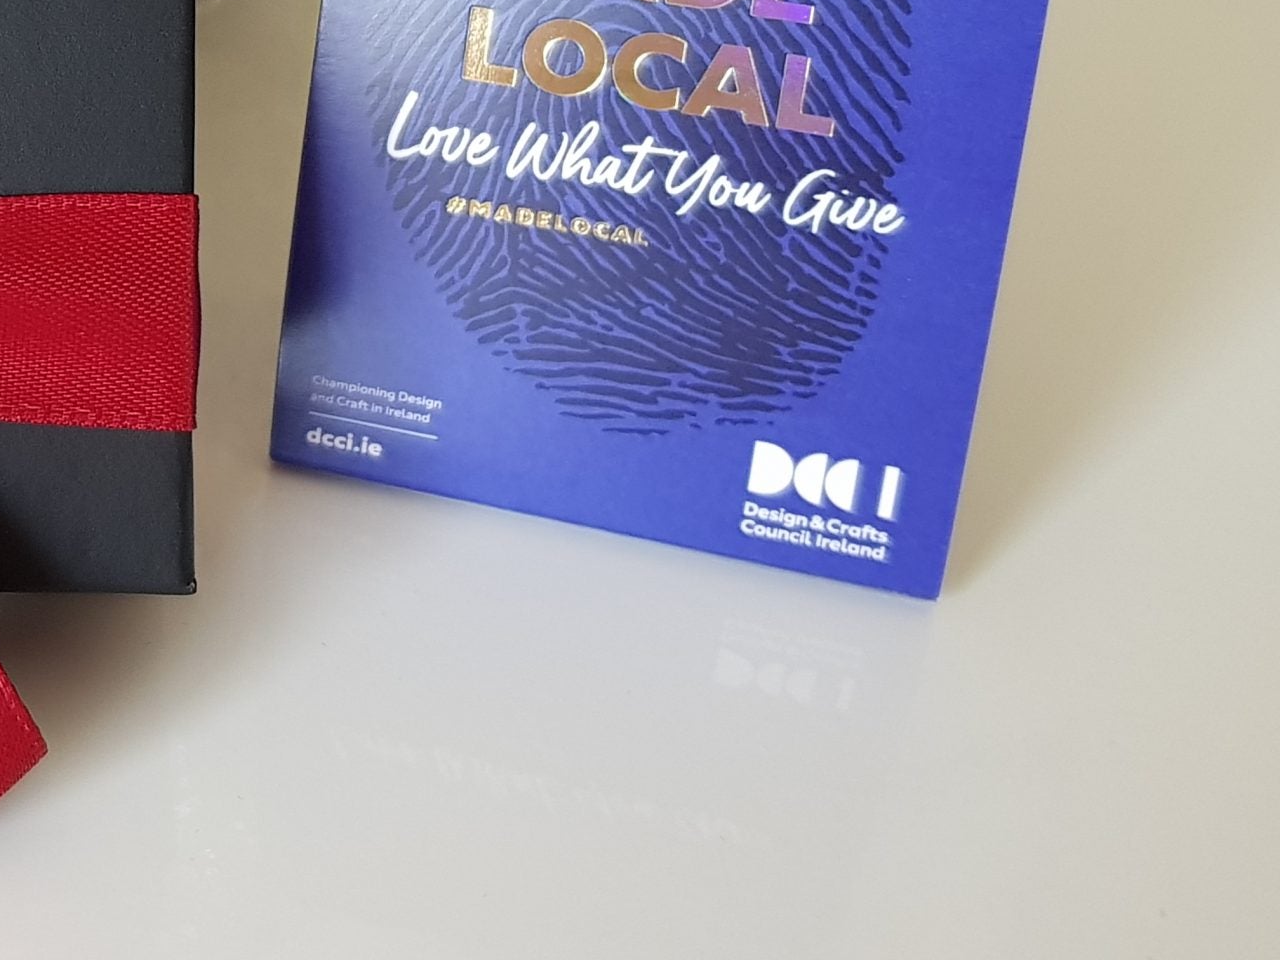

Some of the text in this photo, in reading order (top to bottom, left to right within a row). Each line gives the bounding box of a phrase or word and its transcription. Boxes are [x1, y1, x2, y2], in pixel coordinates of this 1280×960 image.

[462, 5, 836, 138] LOCAL
[387, 91, 905, 235] Love What You Give
[446, 196, 649, 247] #MADELOCAL
[310, 392, 431, 424] and Craft in Ireland
[312, 375, 442, 410] Championing Design
[306, 427, 383, 457] dcci.ie
[740, 519, 888, 561] Council Ireland
